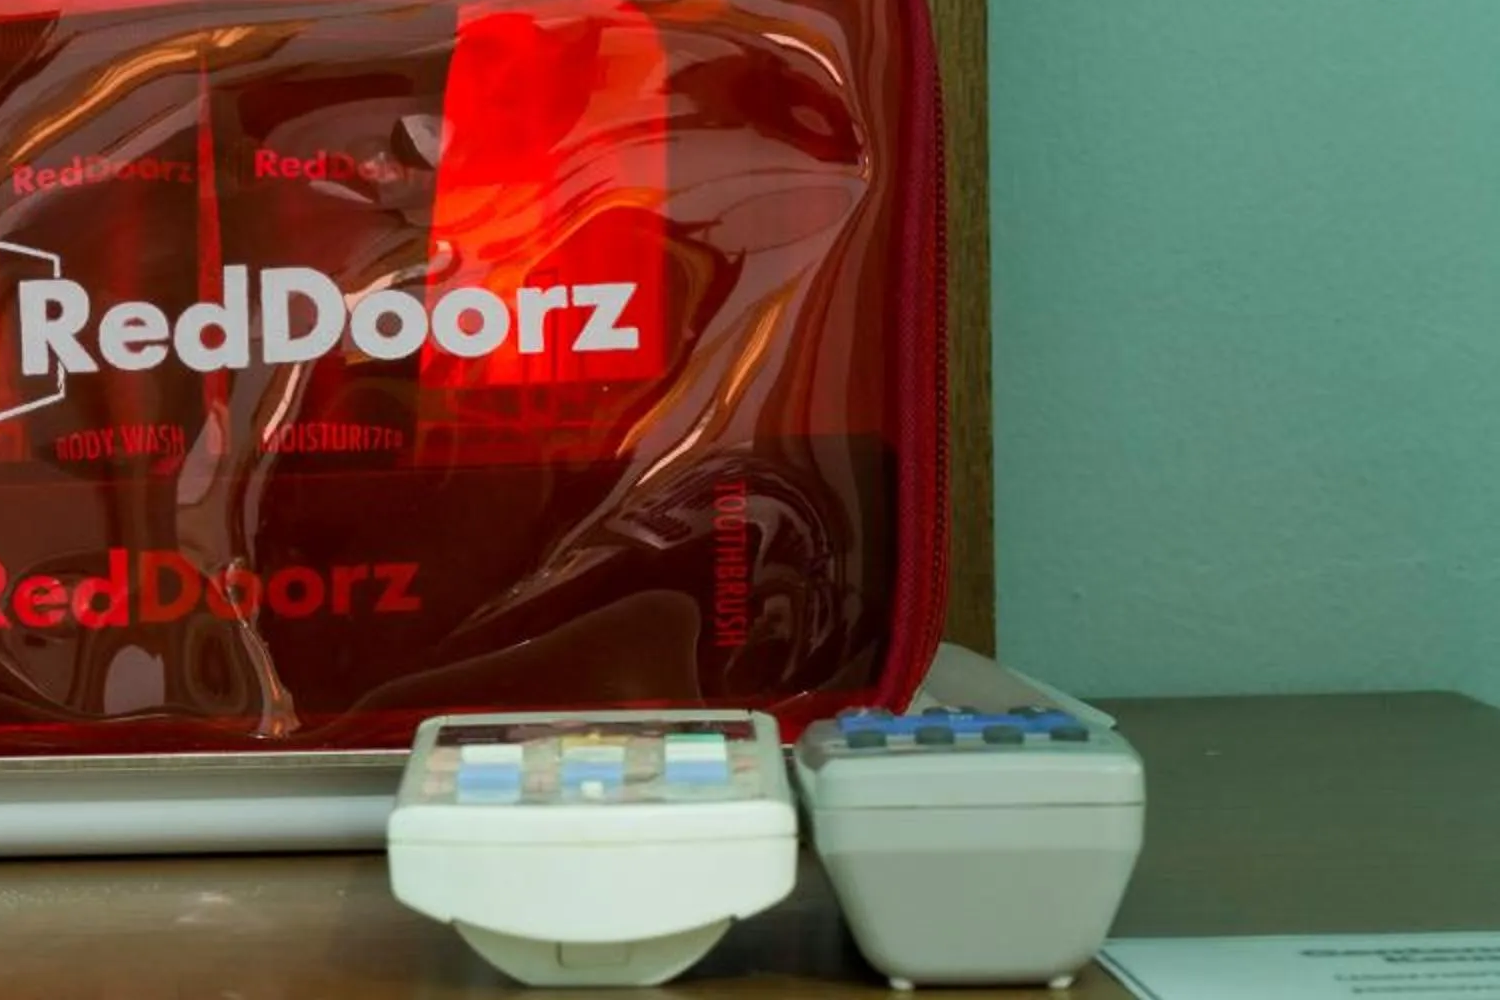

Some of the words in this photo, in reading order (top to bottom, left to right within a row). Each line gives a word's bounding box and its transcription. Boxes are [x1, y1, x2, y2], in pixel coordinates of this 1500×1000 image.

[12, 155, 192, 195] RedDoorz
[18, 264, 640, 376] RedDoorz
[120, 423, 186, 459] WASH
[713, 479, 748, 647] TOOTHBRUSH
